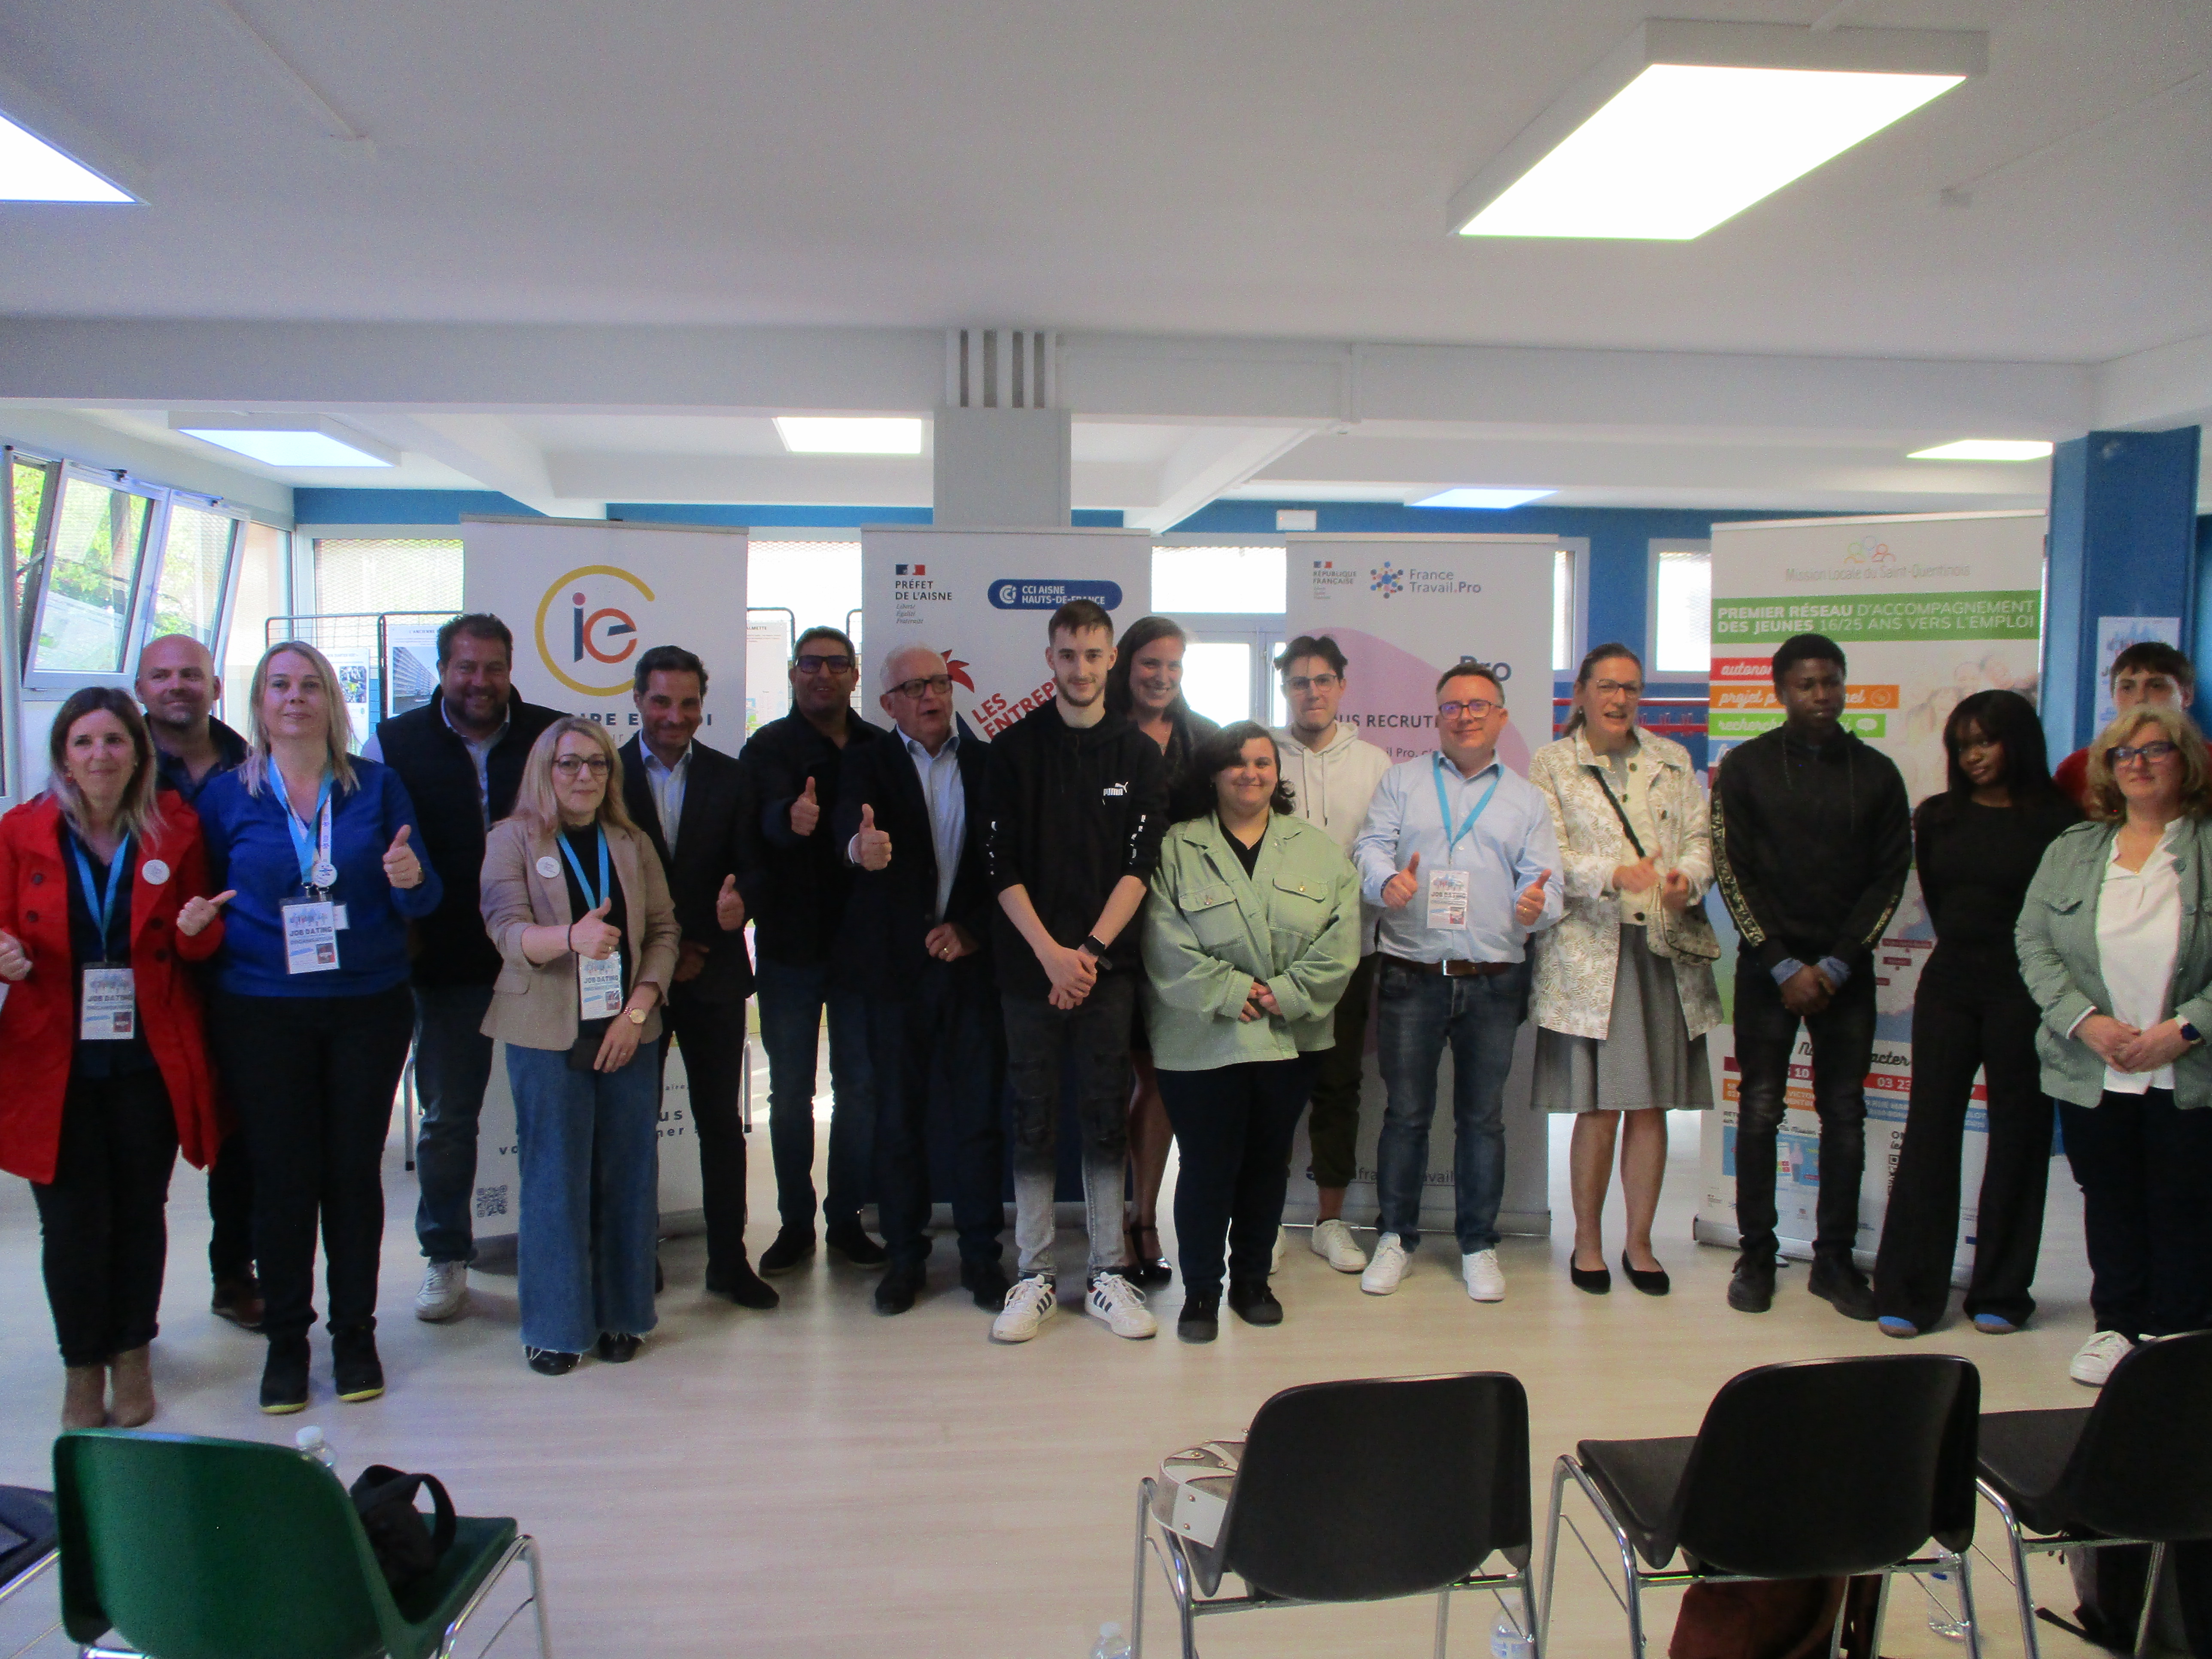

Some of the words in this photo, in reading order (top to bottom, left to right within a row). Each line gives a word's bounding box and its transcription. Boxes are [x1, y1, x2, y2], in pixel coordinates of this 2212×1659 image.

[1410, 569, 1454, 580] France
[895, 579, 933, 589] PRÉFET
[1022, 586, 1036, 594] CCI
[1039, 586, 1065, 594] AISNE
[1409, 581, 1482, 593] Travail.Pro
[895, 592, 909, 600] DE
[913, 592, 953, 601] L'AISNE
[1718, 606, 1785, 619] PREMIER
[1789, 602, 1853, 617] RÉSEAU
[1857, 600, 2036, 616] D'ACCOMPAGNEMENT
[1718, 621, 1749, 633] DES
[1753, 620, 1814, 635] JEUNES
[1821, 618, 1863, 631] 16/25
[1868, 617, 1902, 629] ANS
[1907, 617, 1951, 629] VERS
[1719, 690, 1764, 708] projet
[972, 693, 1007, 724] LES
[983, 677, 1058, 740] ENTREP
[1877, 1077, 1893, 1088] 03
